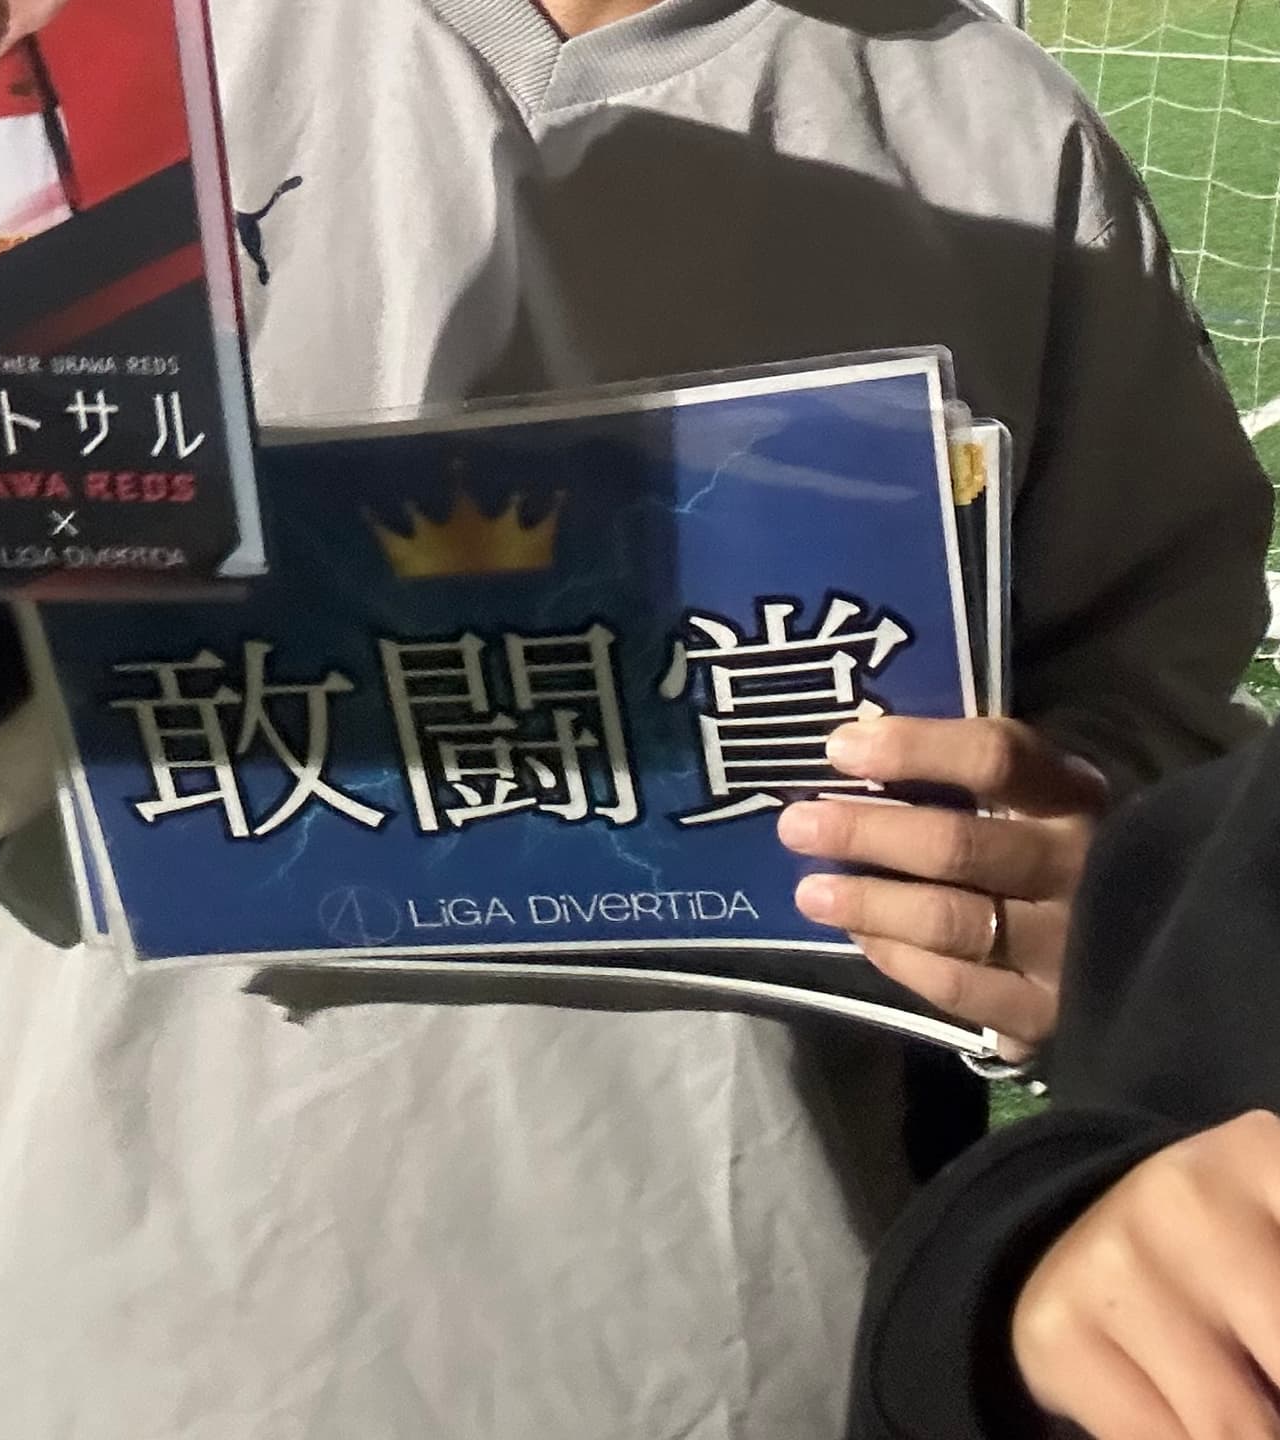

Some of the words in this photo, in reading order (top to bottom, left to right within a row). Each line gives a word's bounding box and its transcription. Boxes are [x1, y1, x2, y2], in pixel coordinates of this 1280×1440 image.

[83, 471, 196, 503] REDS
[110, 596, 912, 839] 敢闘賞
